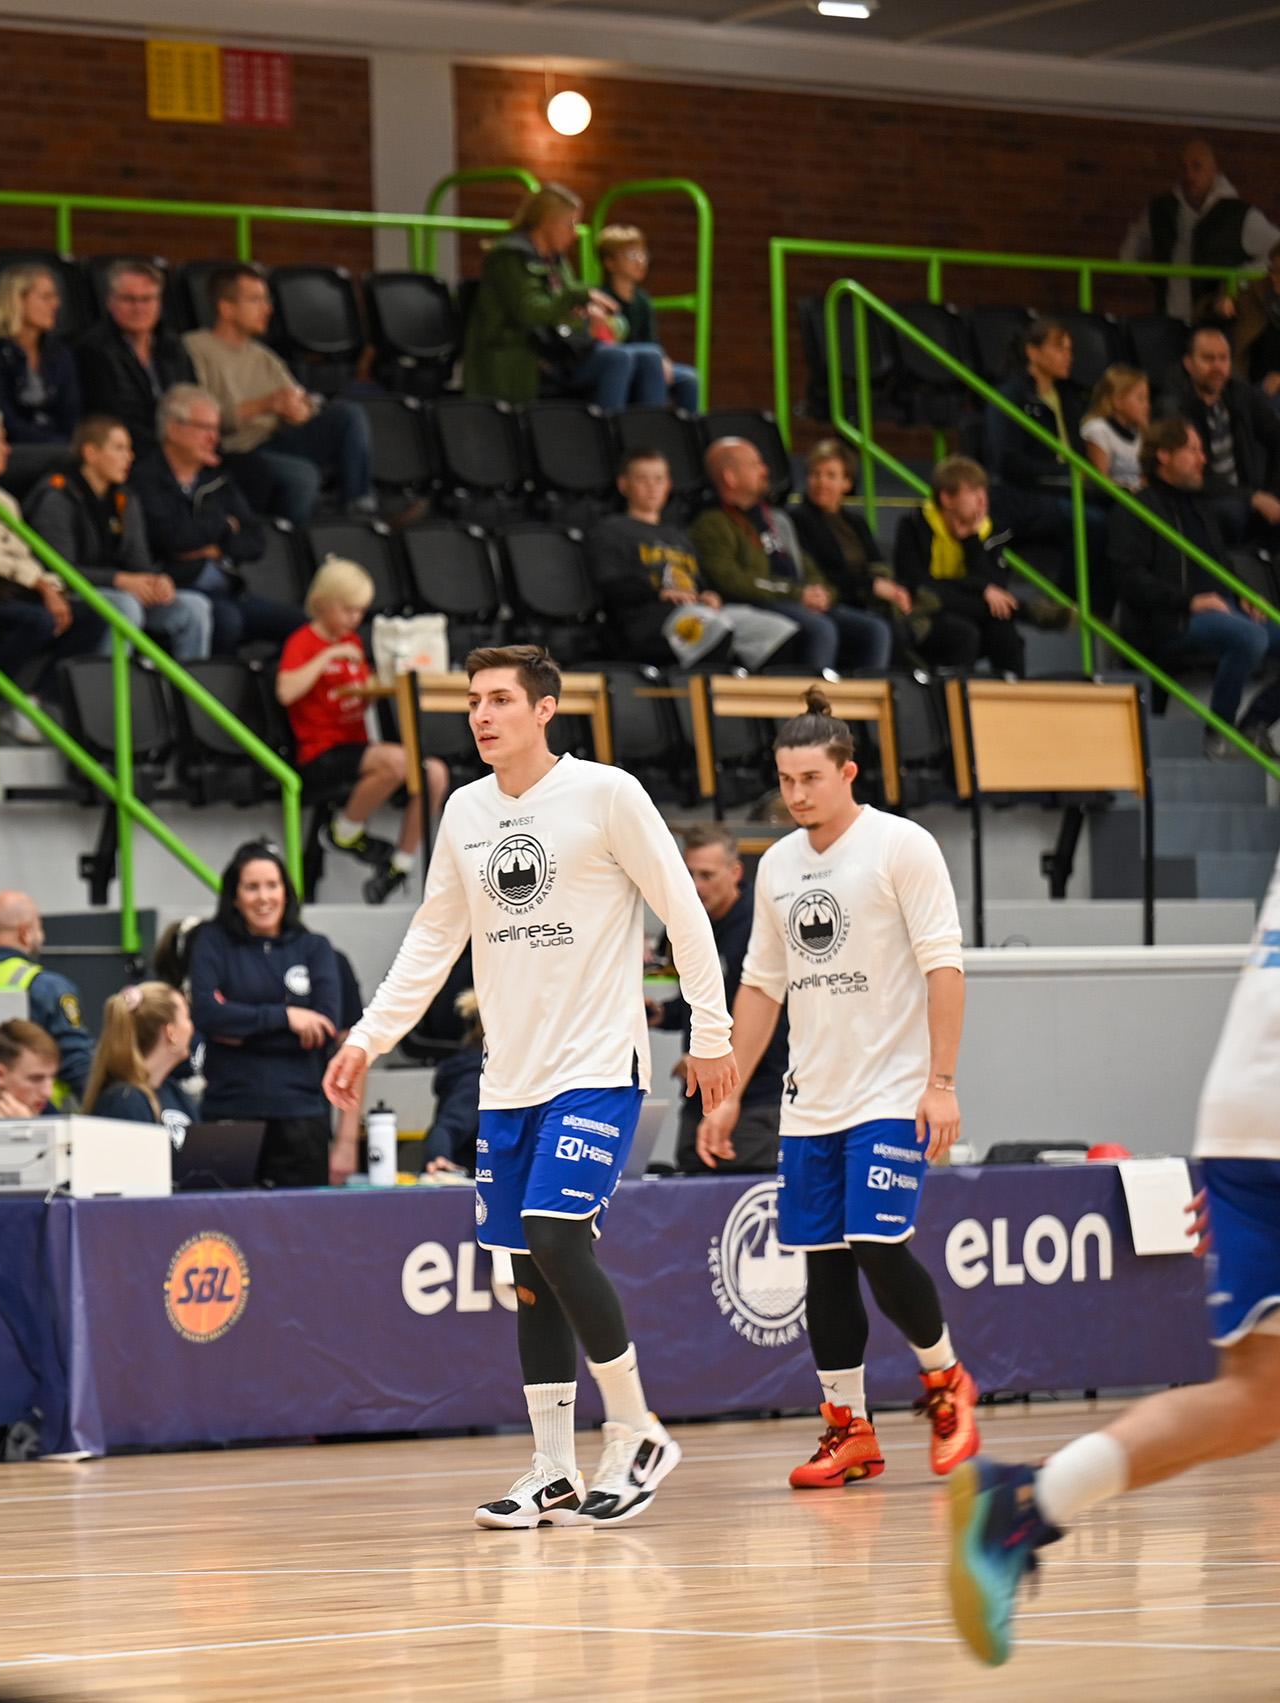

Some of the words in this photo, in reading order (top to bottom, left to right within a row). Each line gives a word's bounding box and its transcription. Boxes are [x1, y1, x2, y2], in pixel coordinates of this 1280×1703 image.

[496, 902, 535, 916] KALMAR
[535, 860, 557, 905] BASKET
[485, 922, 573, 944] wellness
[529, 936, 575, 949] studio
[787, 970, 868, 992] wellness
[177, 1266, 236, 1305] SBL
[707, 1248, 734, 1316] KFUM
[729, 1310, 802, 1348] KALMAR
